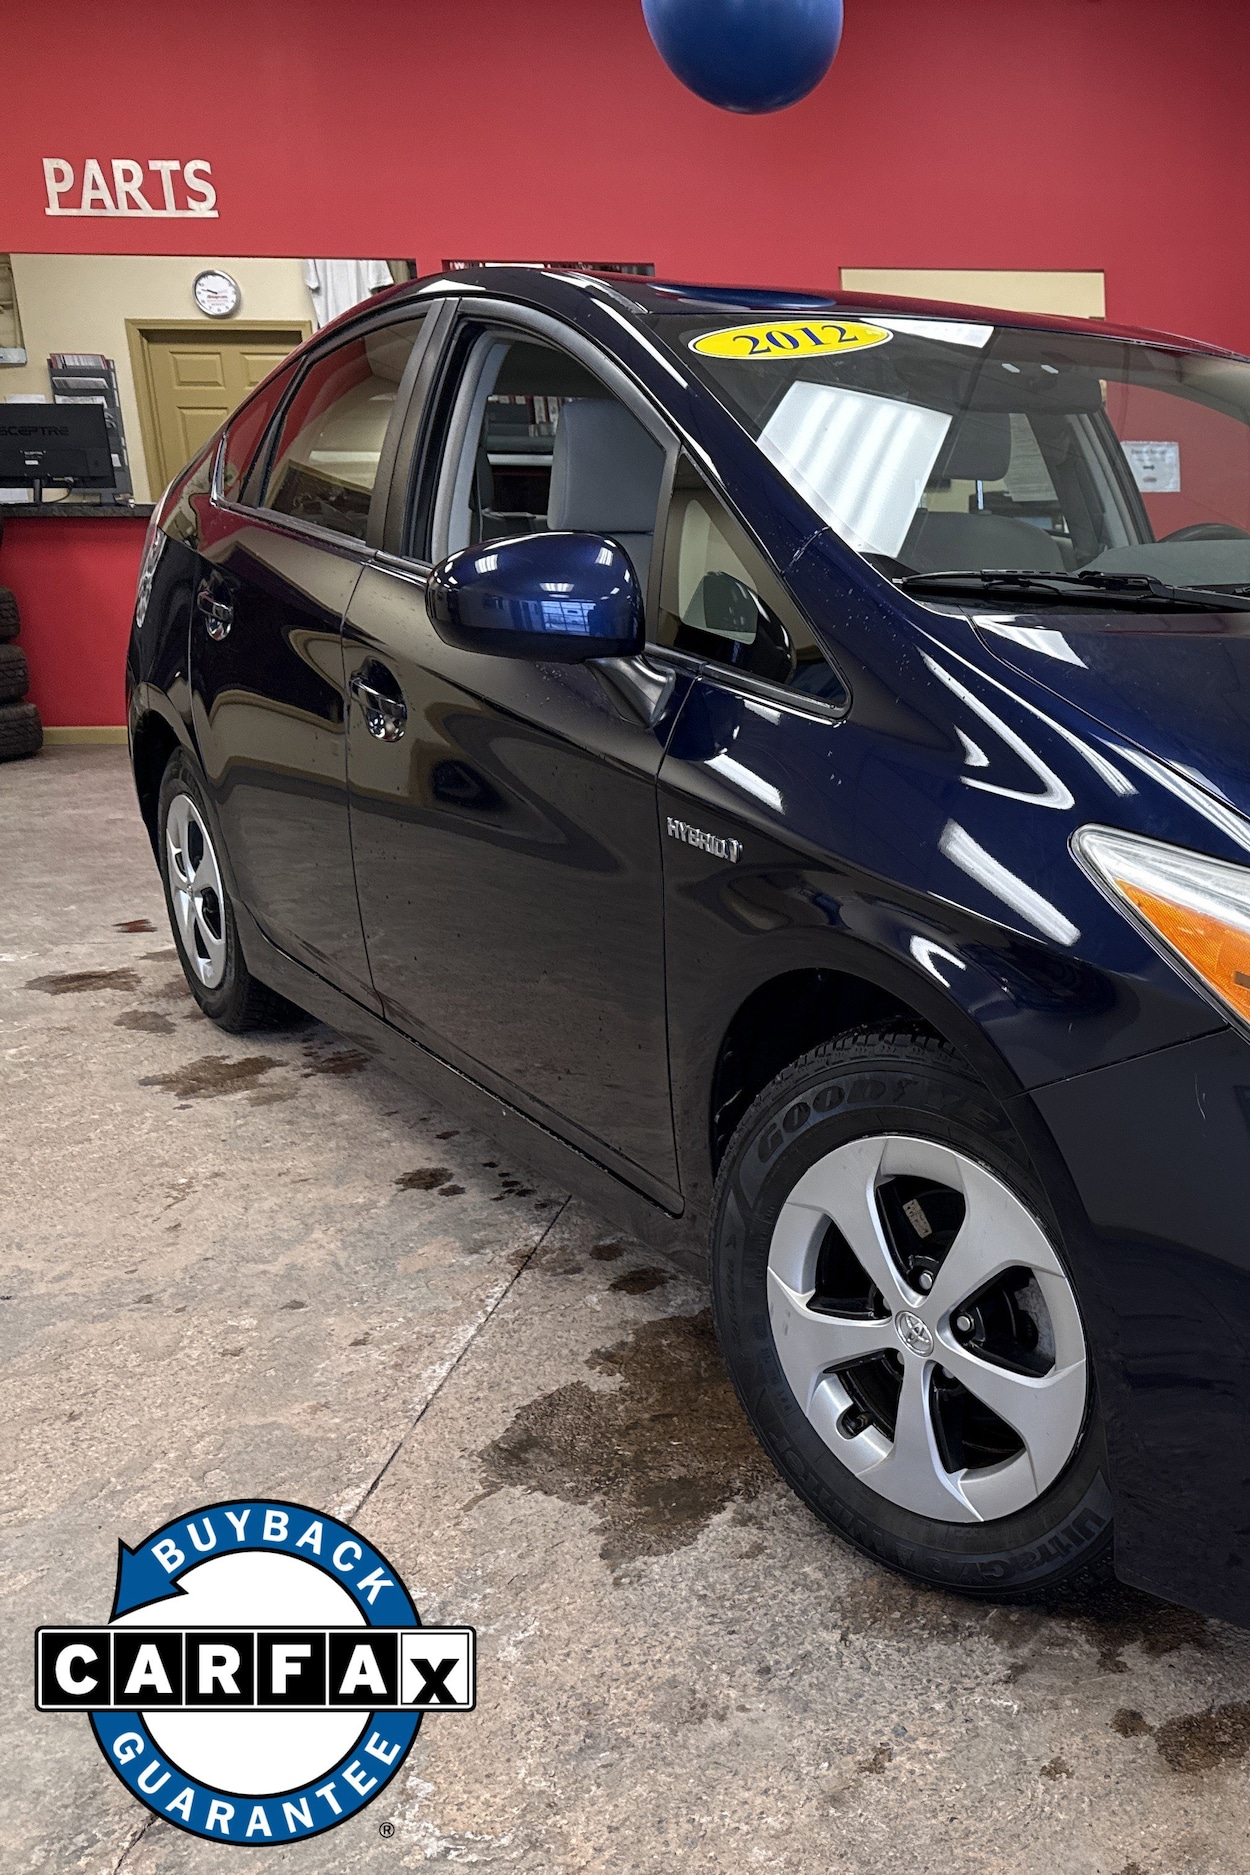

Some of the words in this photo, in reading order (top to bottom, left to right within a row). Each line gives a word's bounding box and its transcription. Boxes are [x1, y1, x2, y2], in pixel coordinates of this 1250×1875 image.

[42, 157, 219, 217] PARTS
[732, 324, 859, 355] 2012
[0, 426, 70, 436] SCEPTRE
[666, 816, 726, 859] HYBRID
